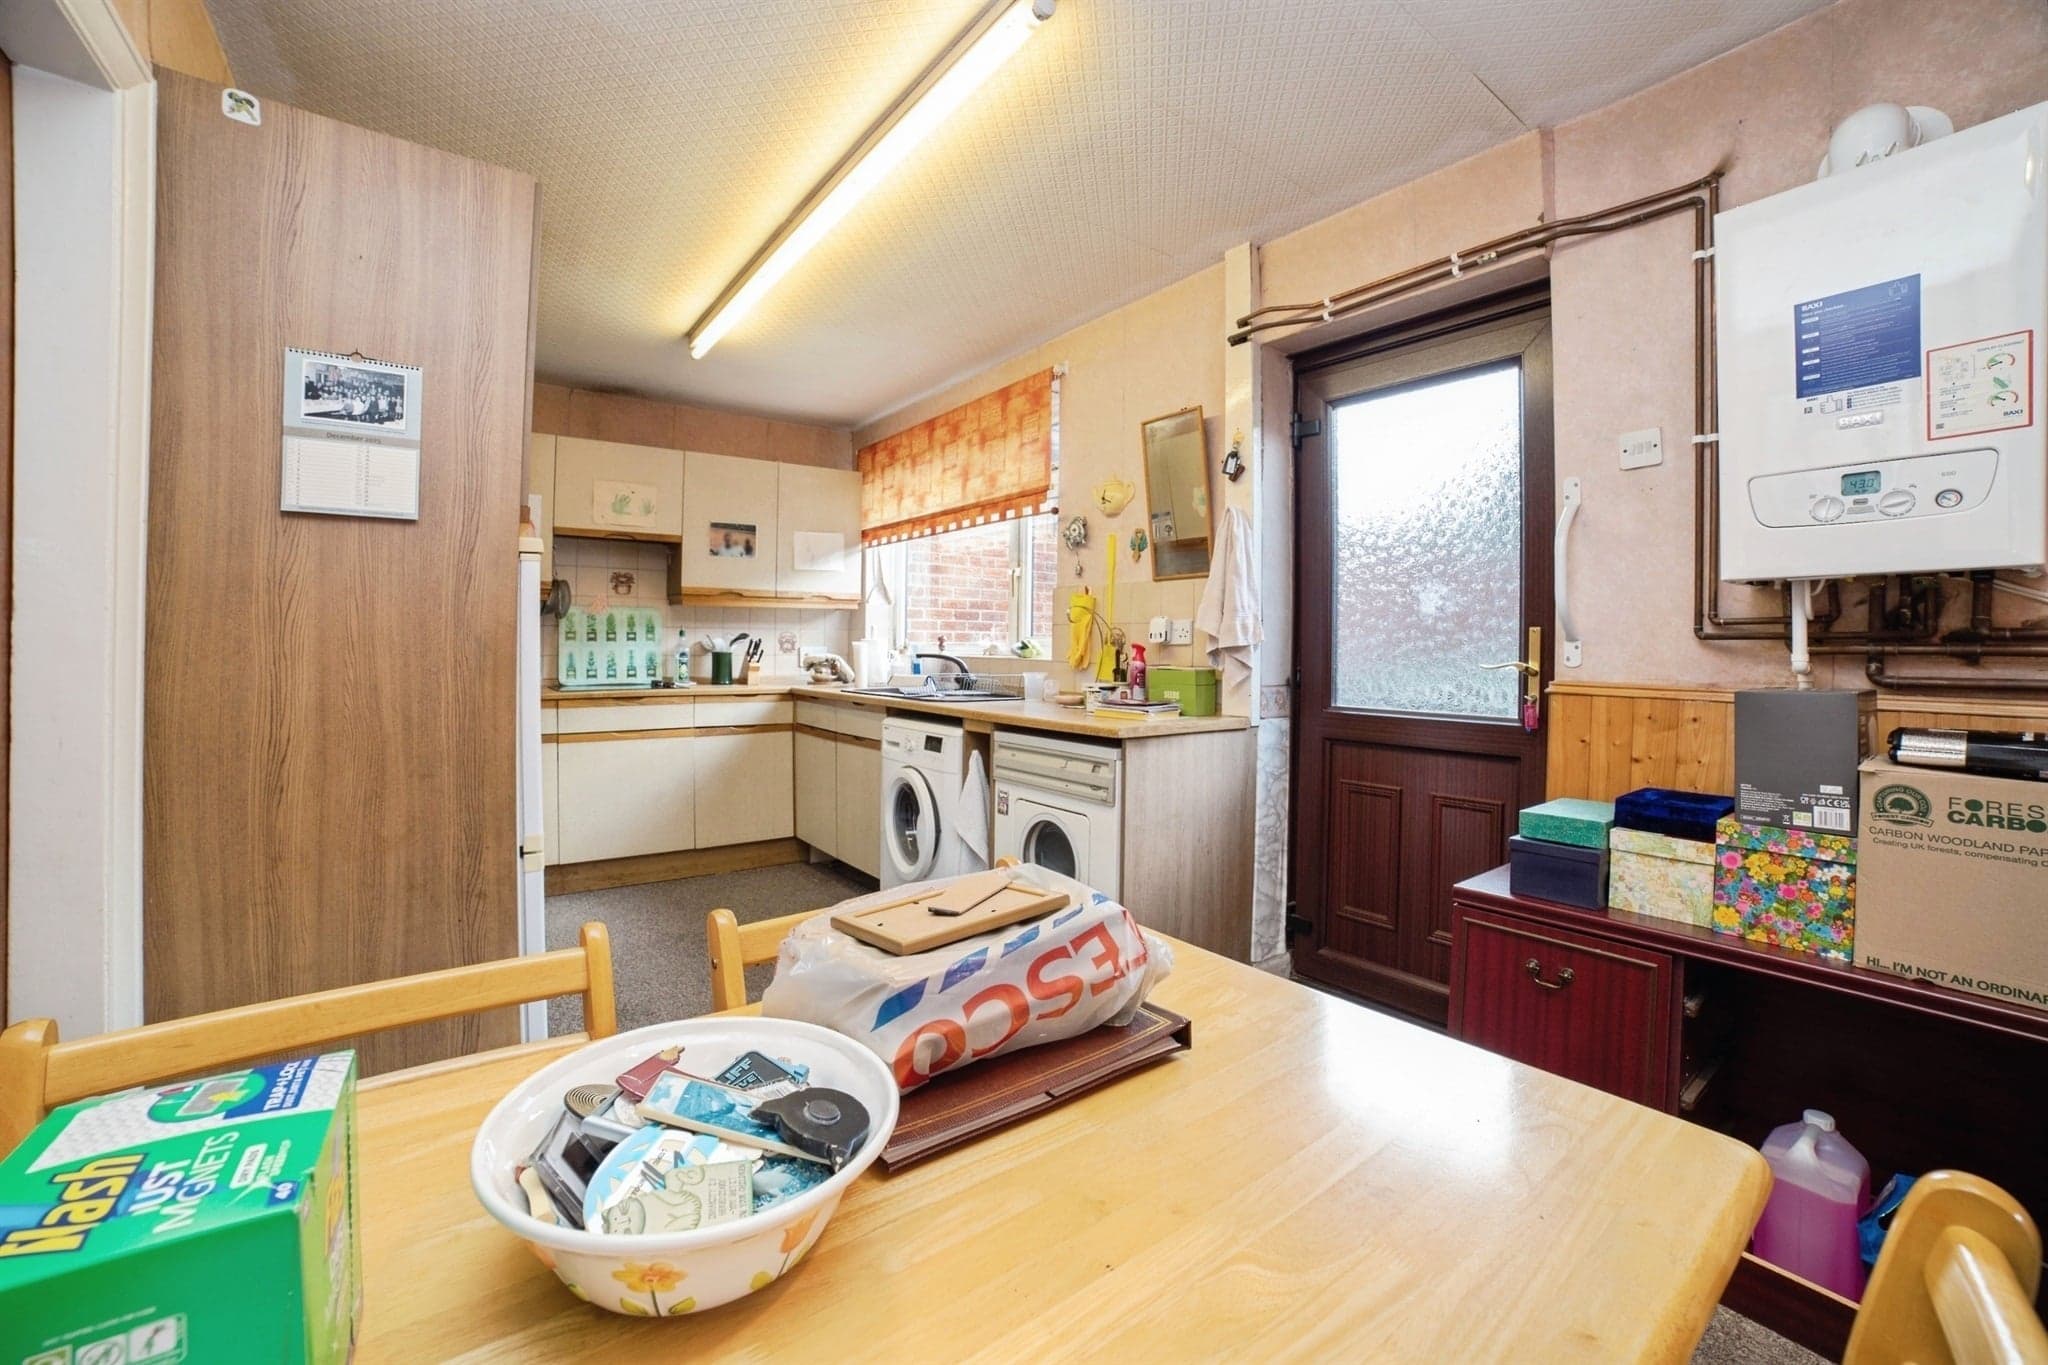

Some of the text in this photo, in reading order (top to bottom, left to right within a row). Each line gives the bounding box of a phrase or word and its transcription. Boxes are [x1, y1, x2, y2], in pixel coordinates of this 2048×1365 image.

[1868, 826, 1924, 841] CARBON
[1927, 835, 2015, 853] WOODLAND
[1872, 837, 1909, 850] Creating
[1927, 845, 1962, 857] forests,
[1964, 851, 2039, 868] compensating
[1893, 961, 1913, 975] I'M
[1916, 967, 1948, 982] NOT
[1950, 975, 1974, 988] AN
